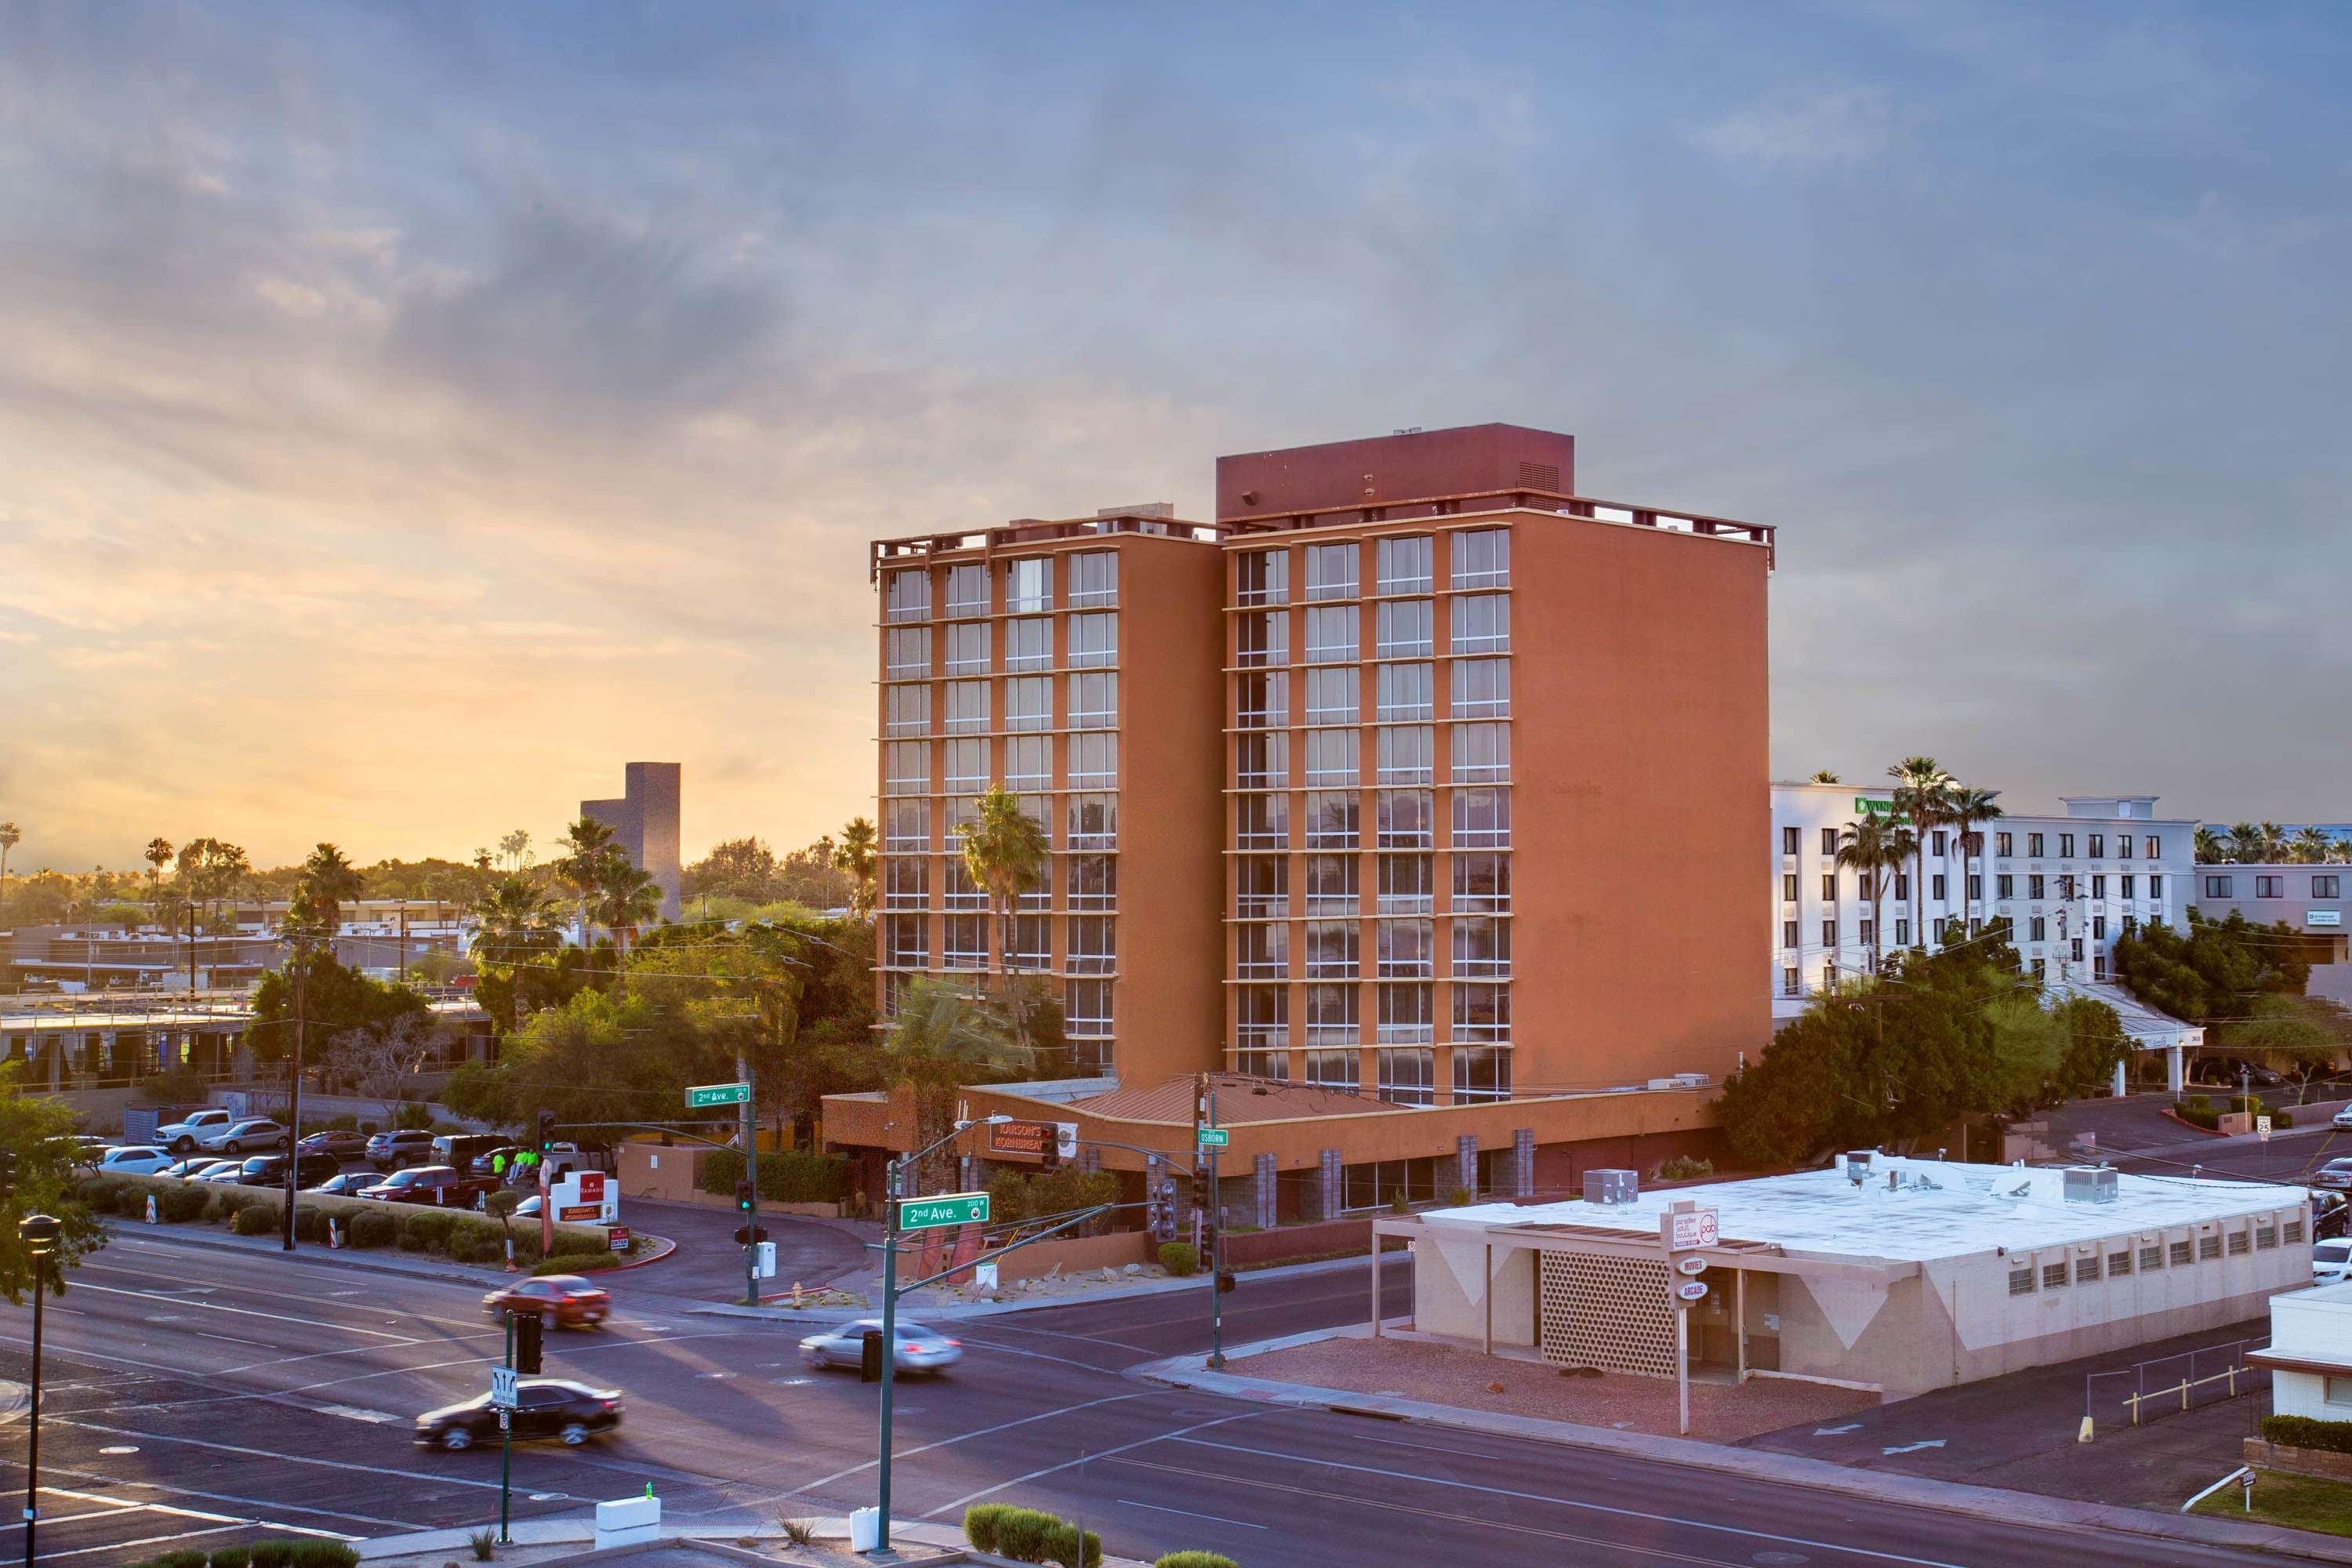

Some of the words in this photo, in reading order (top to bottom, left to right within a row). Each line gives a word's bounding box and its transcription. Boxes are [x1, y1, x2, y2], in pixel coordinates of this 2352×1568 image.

[1867, 800, 1894, 812] WYND
[699, 1093, 711, 1102] 2nd
[712, 1092, 728, 1102] Ave.
[999, 1123, 1042, 1137] KARSON'S
[994, 1136, 1042, 1150] KORNBREA
[1200, 1134, 1224, 1144] OSBORN
[909, 1209, 928, 1222] 2nd
[931, 1207, 956, 1221] Ave.
[1684, 1260, 1702, 1271] MOVIES
[1684, 1285, 1703, 1296] ARCADE
